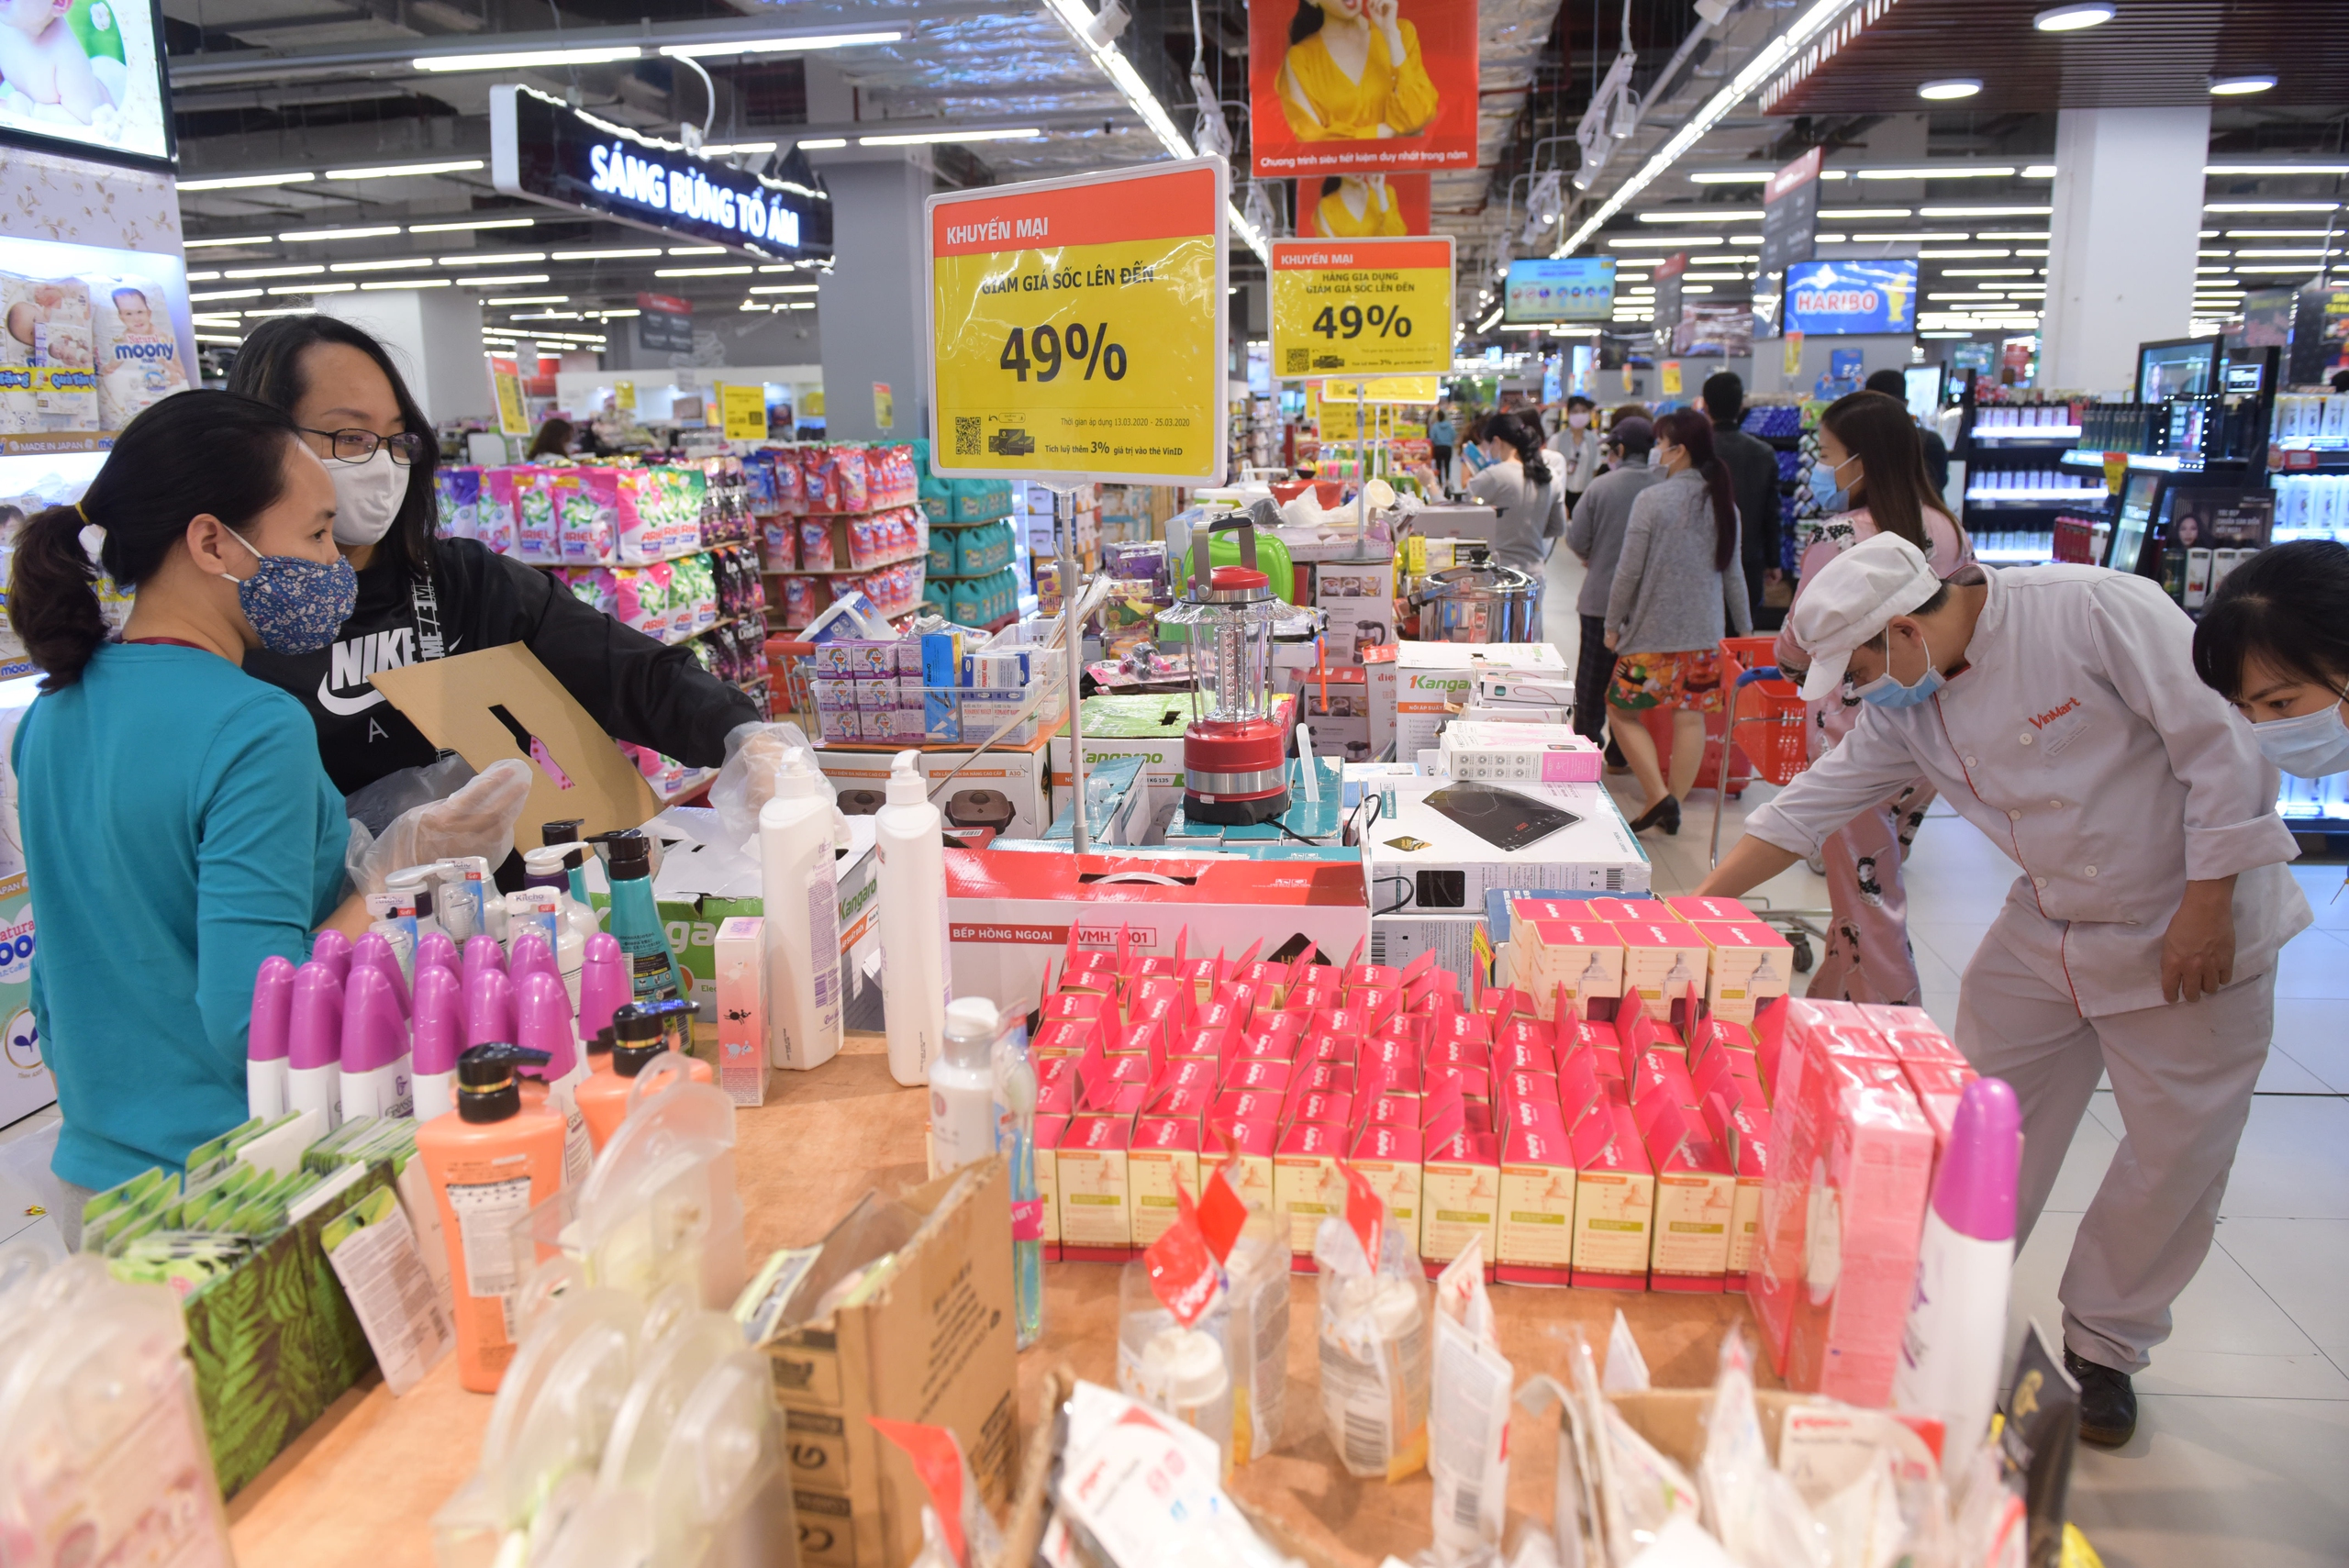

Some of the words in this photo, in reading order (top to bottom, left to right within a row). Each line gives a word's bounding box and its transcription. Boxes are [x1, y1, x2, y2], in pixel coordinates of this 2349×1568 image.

[1379, 151, 1397, 162] duy
[1420, 150, 1445, 161] trong
[590, 140, 667, 209] SÁNG
[669, 166, 736, 229] BỪNG
[947, 217, 1011, 245] KHUYẾN
[1016, 217, 1049, 239] MẠI
[1281, 252, 1329, 265] KHUYẾN
[1330, 254, 1353, 266] MẠI
[1022, 270, 1049, 292] GIÁ
[1052, 266, 1083, 290] SỐC
[1086, 264, 1116, 287] LÊN
[1119, 261, 1154, 285] ĐẾN
[1322, 271, 1349, 282] HÀNG
[1352, 273, 1369, 282] GIA
[1372, 272, 1398, 284] DỤNG
[1334, 282, 1353, 294] GIÁ
[1354, 281, 1373, 293] SỐC
[1375, 281, 1394, 293] LÊN
[1396, 280, 1415, 292] ĐẾN
[1796, 290, 1878, 315] HARIBO
[1312, 304, 1412, 339] 49%
[116, 343, 173, 361] moony
[1000, 322, 1128, 383] 49%
[1061, 417, 1074, 426] Thời
[1075, 418, 1087, 428] gian
[1089, 417, 1097, 428] áp
[1097, 417, 1113, 428] dụng
[1114, 417, 1149, 427] 13.03.2020
[1155, 417, 1190, 427] 25.03.2020
[20, 442, 44, 450] MADE
[56, 441, 83, 450] JAPAN
[1045, 445, 1059, 453] Tích
[1072, 445, 1089, 453] thêm
[1090, 441, 1110, 454] 3%
[1125, 446, 1134, 457] trị
[1135, 446, 1148, 455] vào
[1163, 447, 1184, 456] VinID
[563, 531, 596, 542] ARIEL
[641, 531, 662, 541] ARIE
[331, 627, 417, 691] NIKE
[1409, 674, 1471, 693] Kanga
[2028, 697, 2081, 730] VinMart
[516, 893, 544, 902] Kitcho
[839, 878, 877, 925] Kangaro
[0, 919, 35, 941] atura
[952, 925, 975, 940] BẾP
[978, 925, 1013, 941] HỒNG
[1014, 929, 1053, 942] NGOẠI
[1077, 931, 1111, 943] VMH
[1115, 931, 1148, 944] 001
[385, 1095, 413, 1118] GRASS
